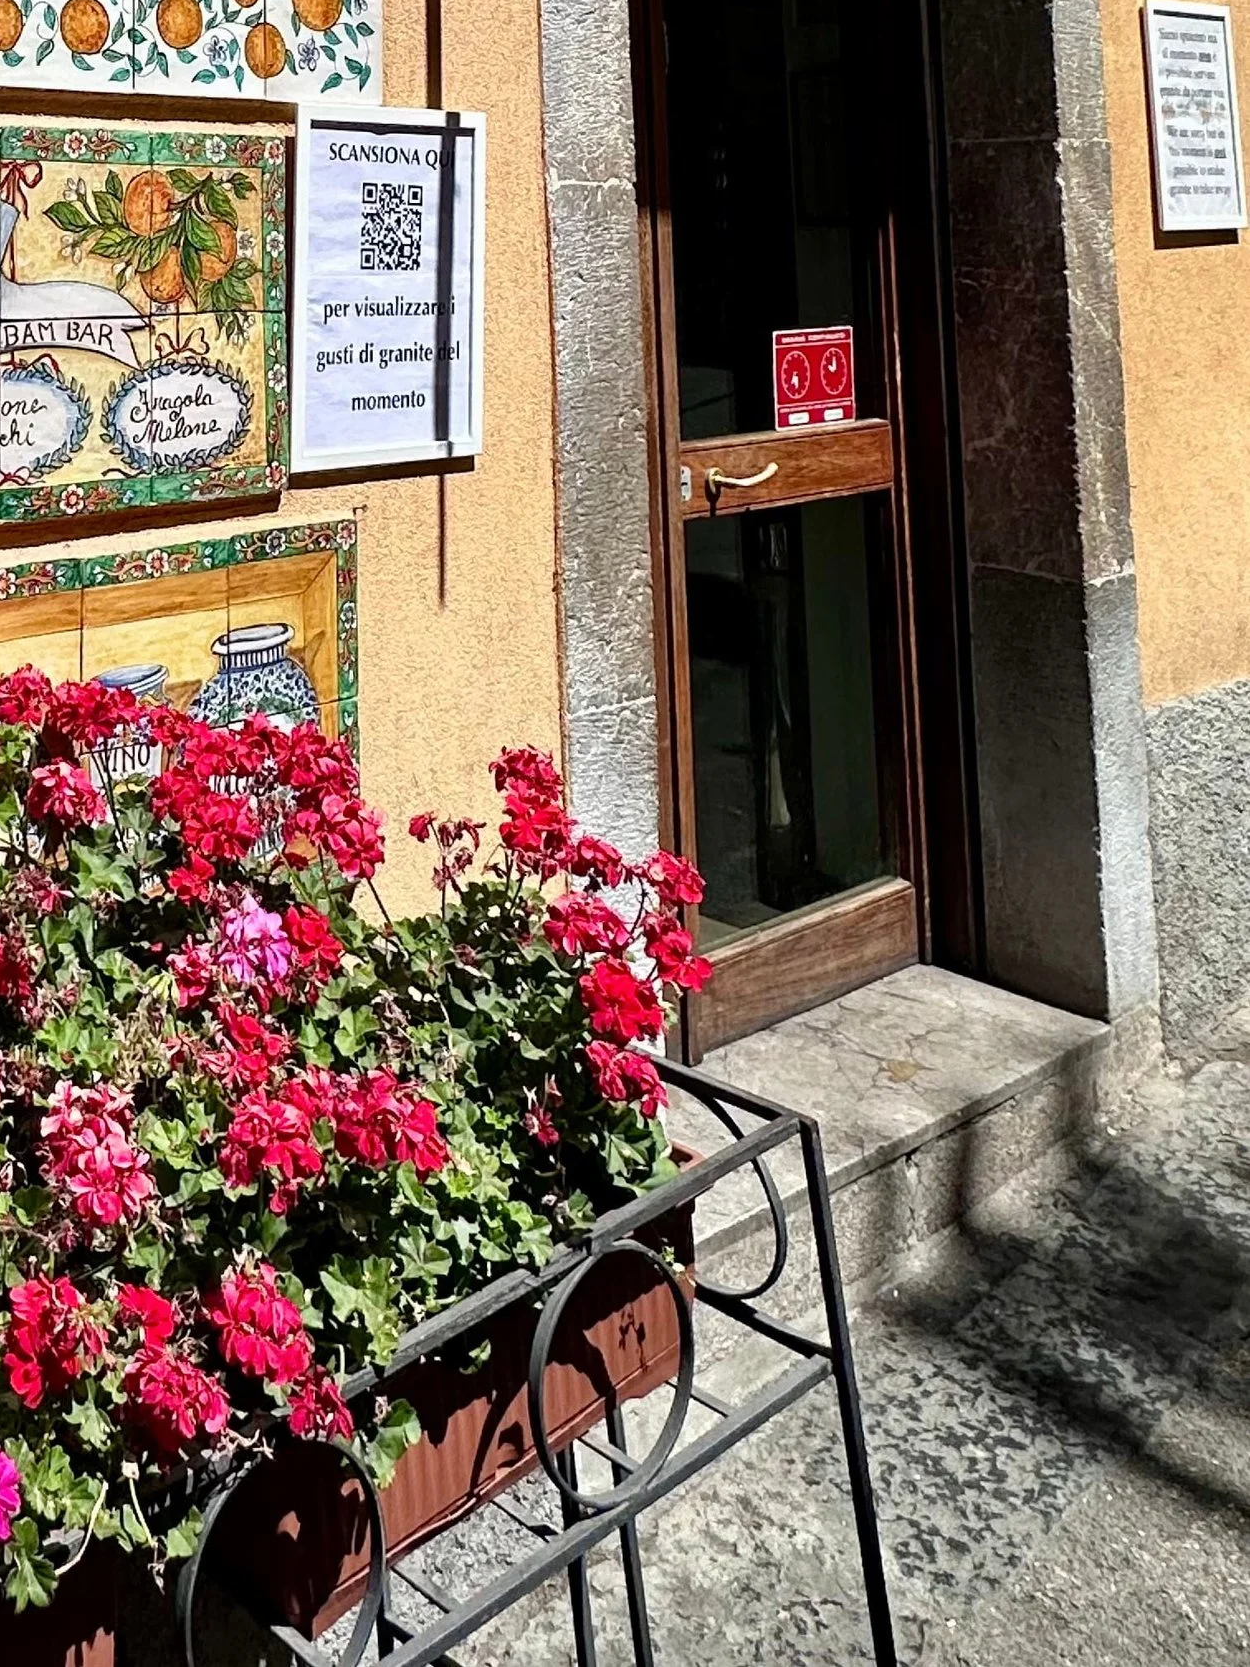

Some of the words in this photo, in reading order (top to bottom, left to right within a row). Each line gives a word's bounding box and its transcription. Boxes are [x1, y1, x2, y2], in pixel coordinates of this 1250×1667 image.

[329, 142, 420, 166] SCANSIONA
[425, 149, 455, 170] QUI
[323, 300, 350, 325] per
[355, 295, 447, 318] visualizzare
[451, 295, 455, 315] i
[4, 321, 56, 348] BAM
[66, 321, 115, 352] BAR
[316, 344, 354, 372] gusti
[359, 342, 375, 363] di
[379, 340, 433, 369] granite
[437, 340, 460, 361] del
[129, 384, 217, 422] Fragola
[351, 389, 426, 412] momento
[133, 418, 222, 444] Melone
